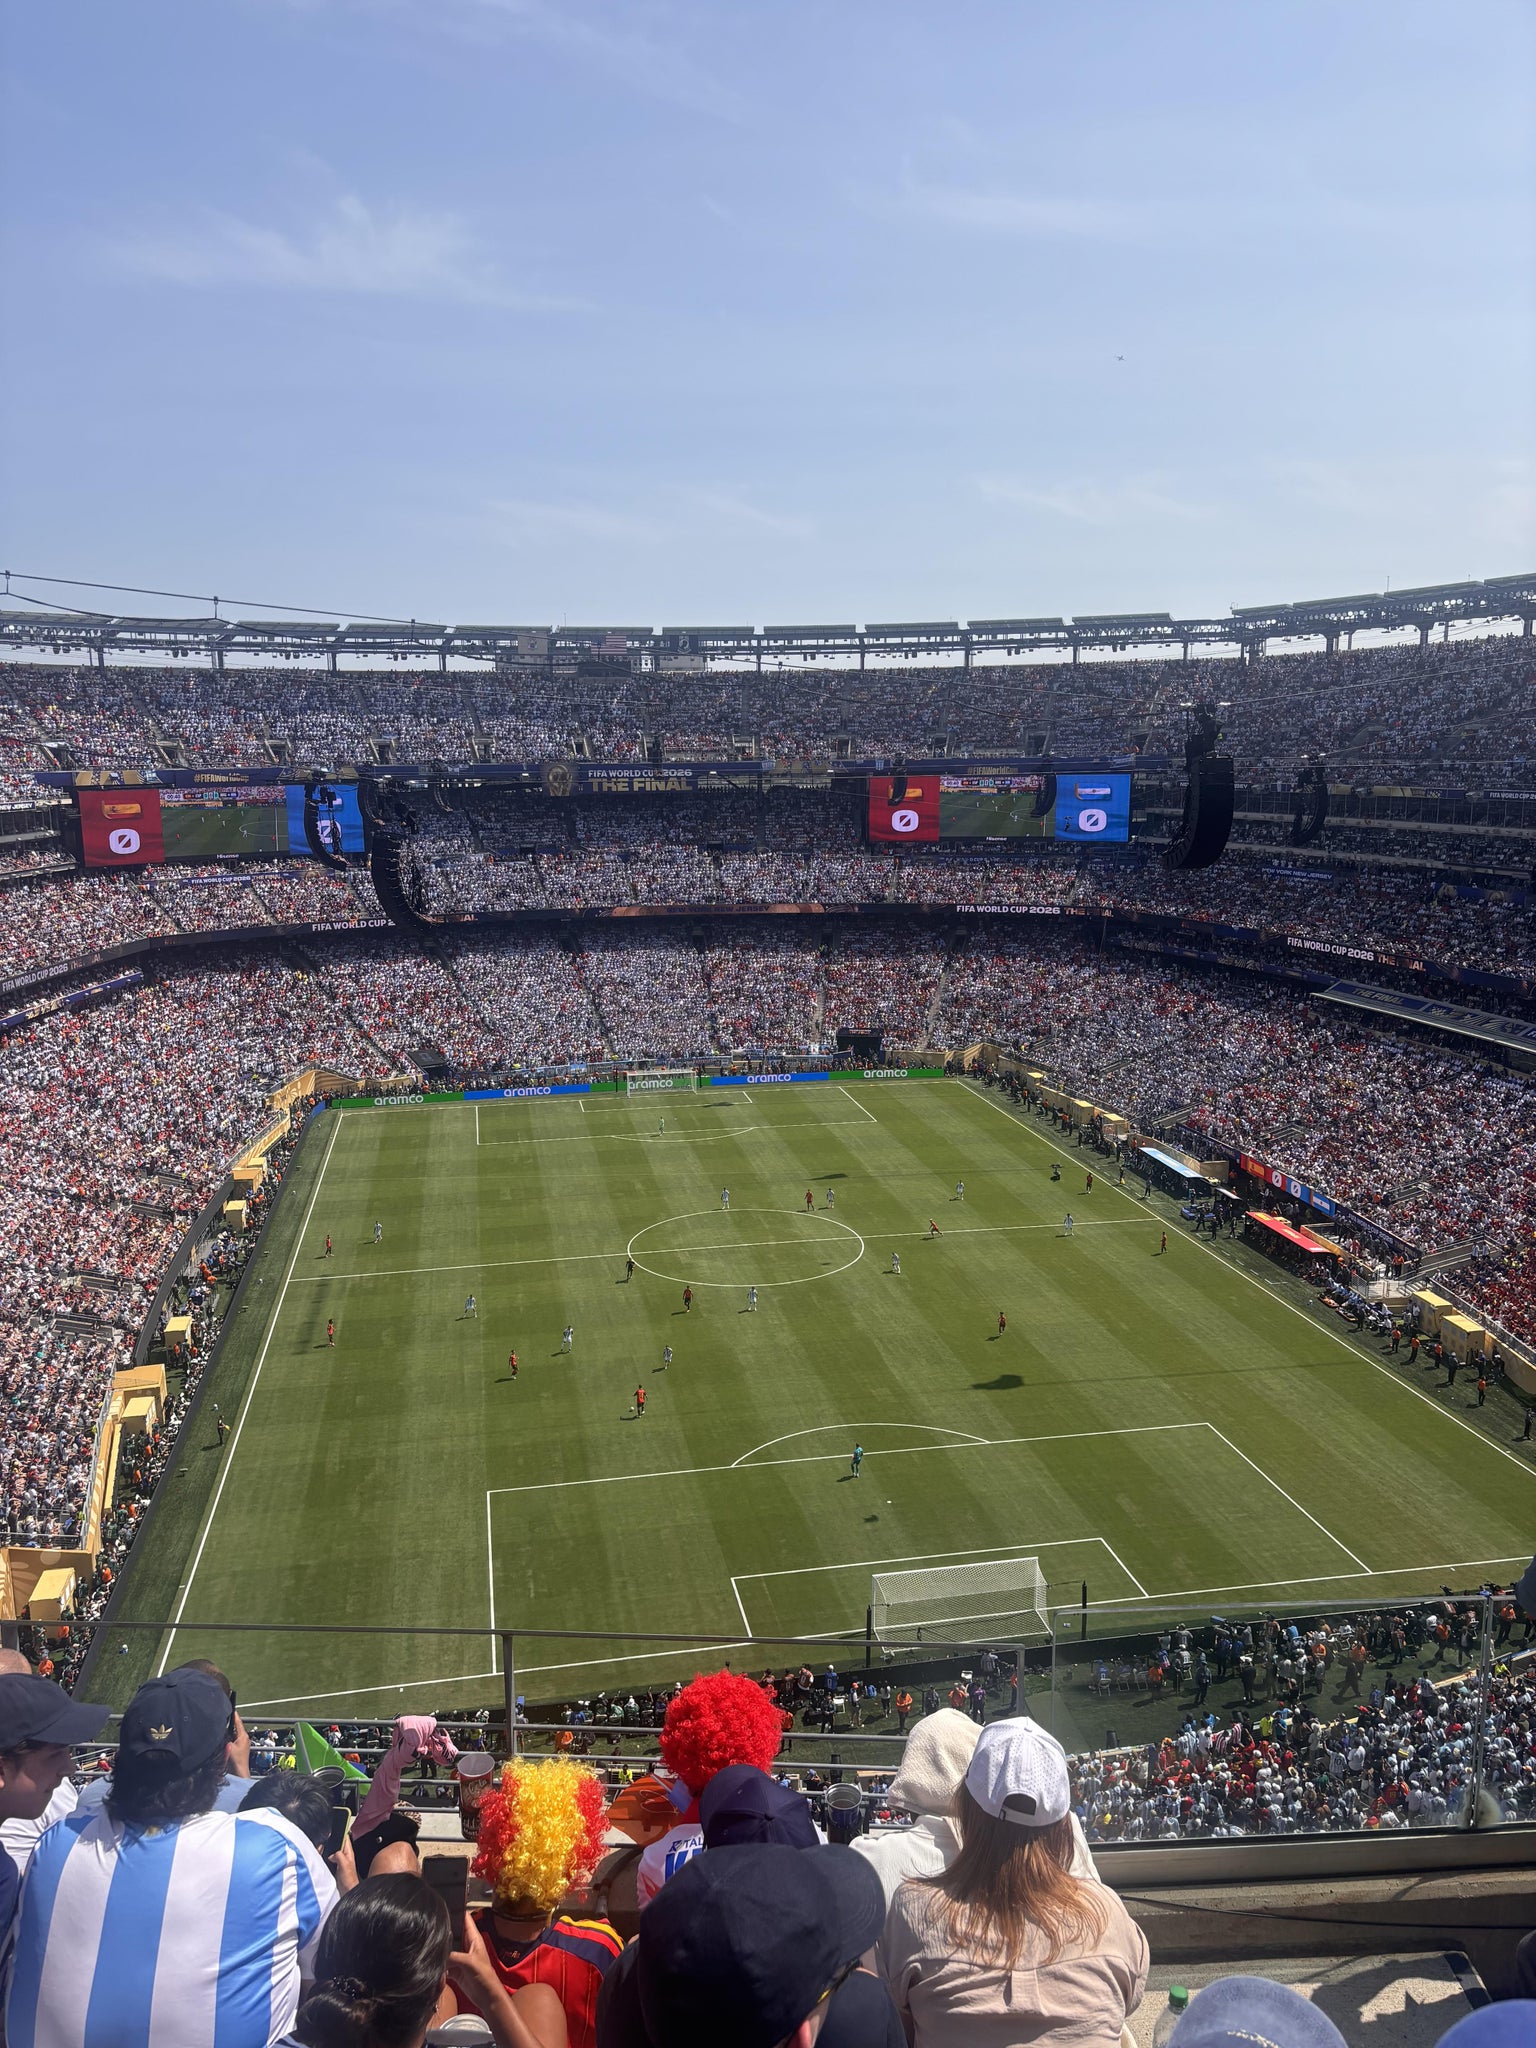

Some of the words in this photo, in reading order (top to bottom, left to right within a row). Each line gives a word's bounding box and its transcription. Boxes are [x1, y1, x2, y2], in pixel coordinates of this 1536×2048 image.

[609, 769, 641, 777] WORLD
[589, 778, 629, 792] THE
[633, 778, 693, 791] FINAL
[956, 905, 975, 913] FIFA
[977, 905, 1008, 913] WORLD
[1010, 906, 1028, 914] CUP
[1029, 906, 1061, 915] 2026
[1064, 907, 1085, 917] THE
[312, 920, 333, 931] FIFA
[332, 919, 367, 930] WORLD
[368, 919, 387, 928] CUP
[1287, 937, 1303, 948] FIFA
[1303, 939, 1331, 953] WORLD
[1331, 945, 1347, 956] CUP
[1347, 948, 1375, 961] 2026
[1376, 952, 1396, 966] THE
[2, 980, 16, 992] FIFA
[15, 973, 37, 988] WORLD
[37, 968, 49, 980] CUP
[49, 963, 69, 977] 2026
[746, 1073, 792, 1083] aramco
[863, 1069, 908, 1078] aramco
[629, 1079, 673, 1089] aramco
[504, 1086, 551, 1097] aramco
[374, 1094, 424, 1106] aramco
